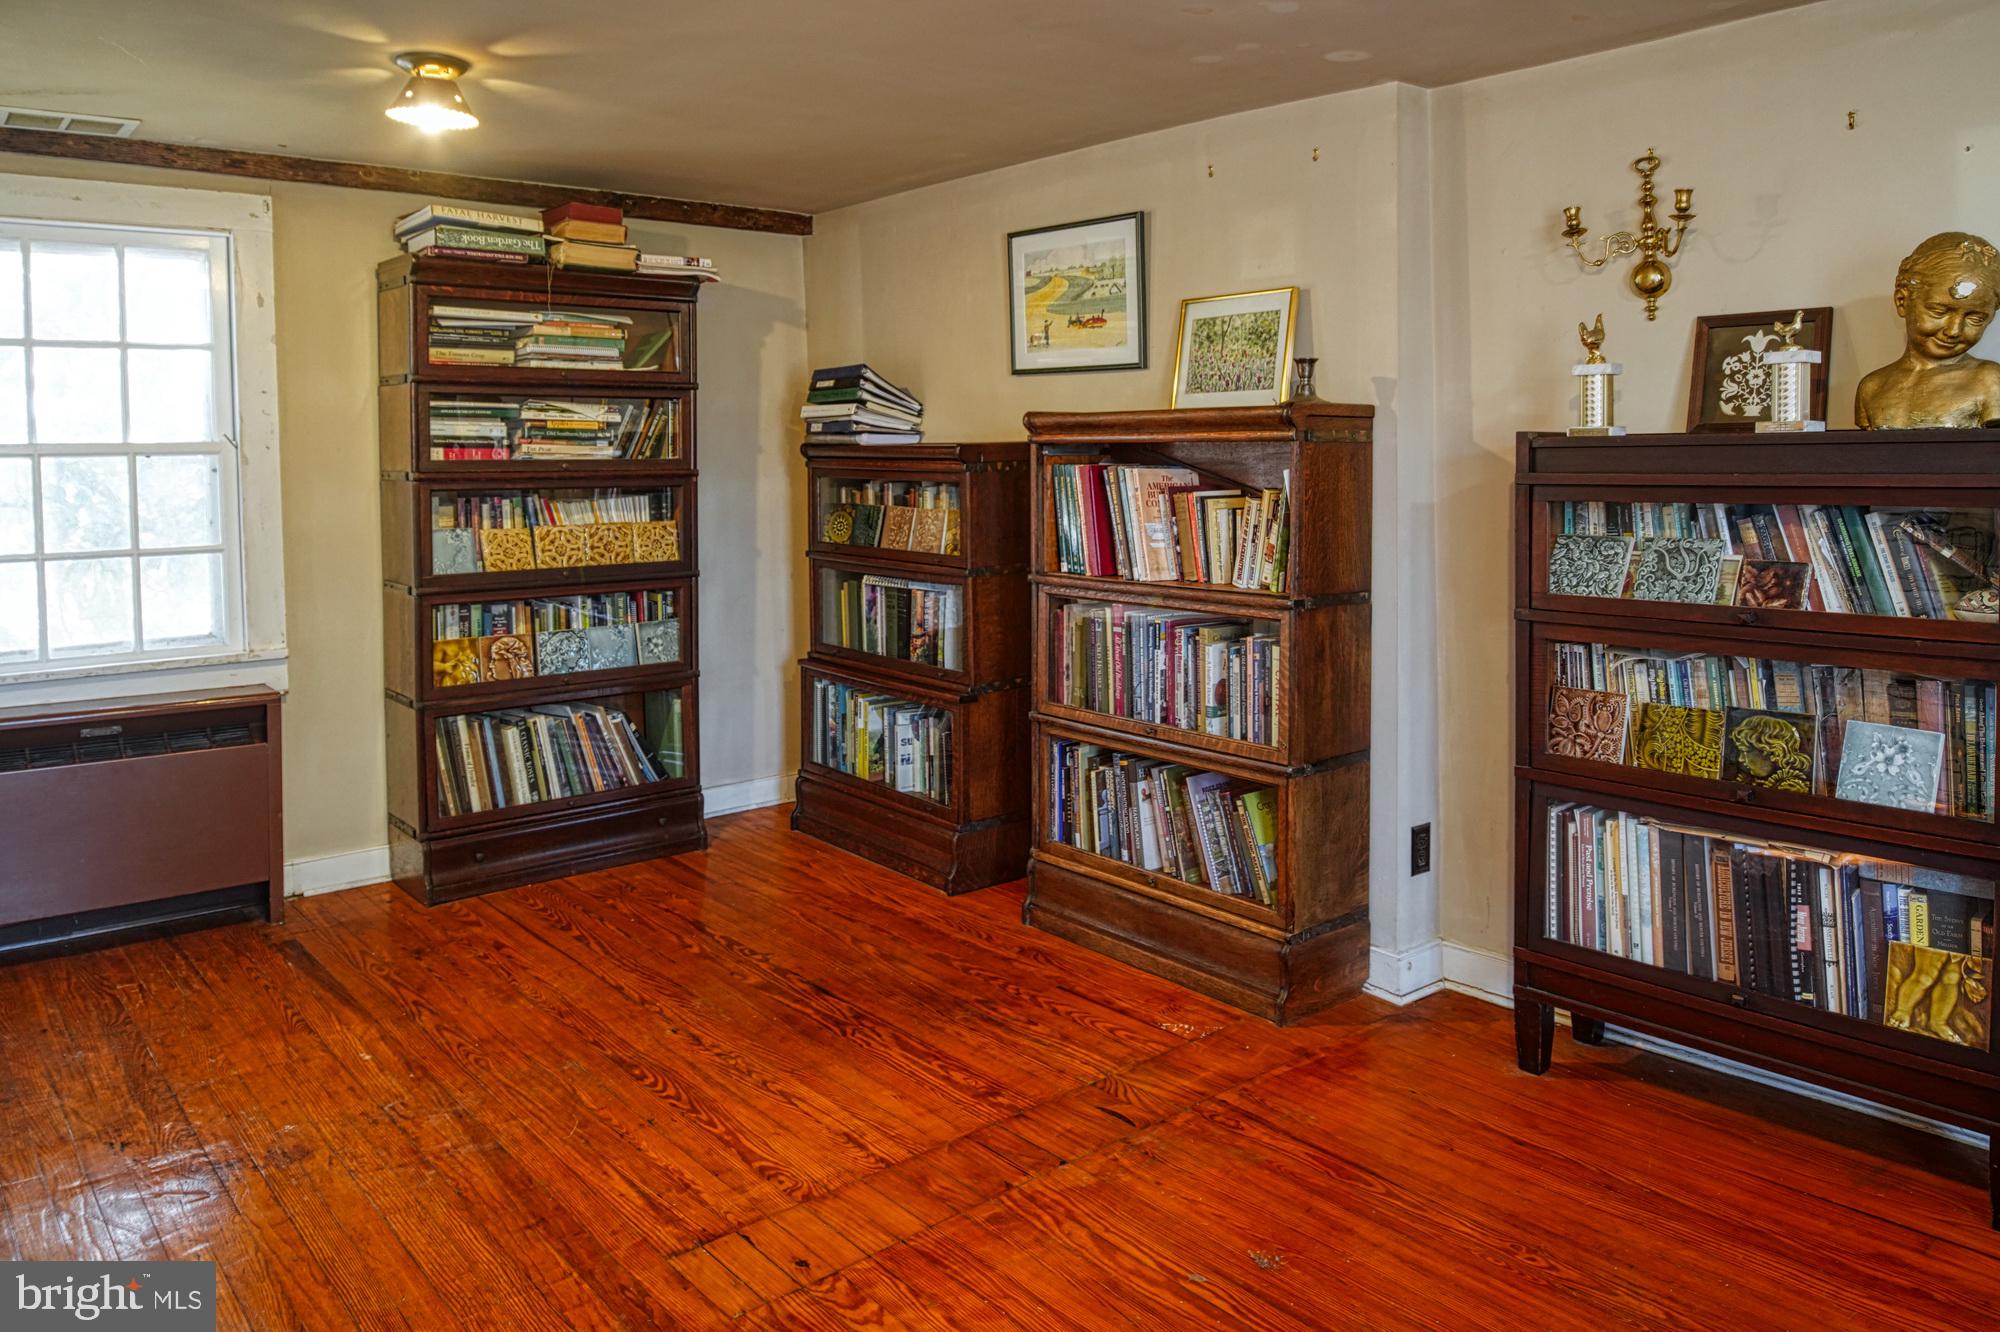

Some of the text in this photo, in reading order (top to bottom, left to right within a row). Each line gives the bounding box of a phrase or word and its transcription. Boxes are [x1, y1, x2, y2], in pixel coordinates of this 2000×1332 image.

[477, 211, 524, 225] HARVEST
[461, 234, 541, 250] The Garden Book
[1237, 537, 1247, 581] BLACKSMITHING
[1837, 518, 1861, 577] DAMMING DELAWARE
[518, 730, 532, 760] CLASSIC
[1585, 844, 1593, 862] Past
[1586, 879, 1594, 911] Promise
[1717, 864, 1734, 963] AGRICULTURE IN NEW JERSEY
[1797, 911, 1807, 925] New
[1916, 904, 1924, 943] GARDEN
[1796, 926, 1807, 943] Jersey
[1885, 923, 1894, 939] South
